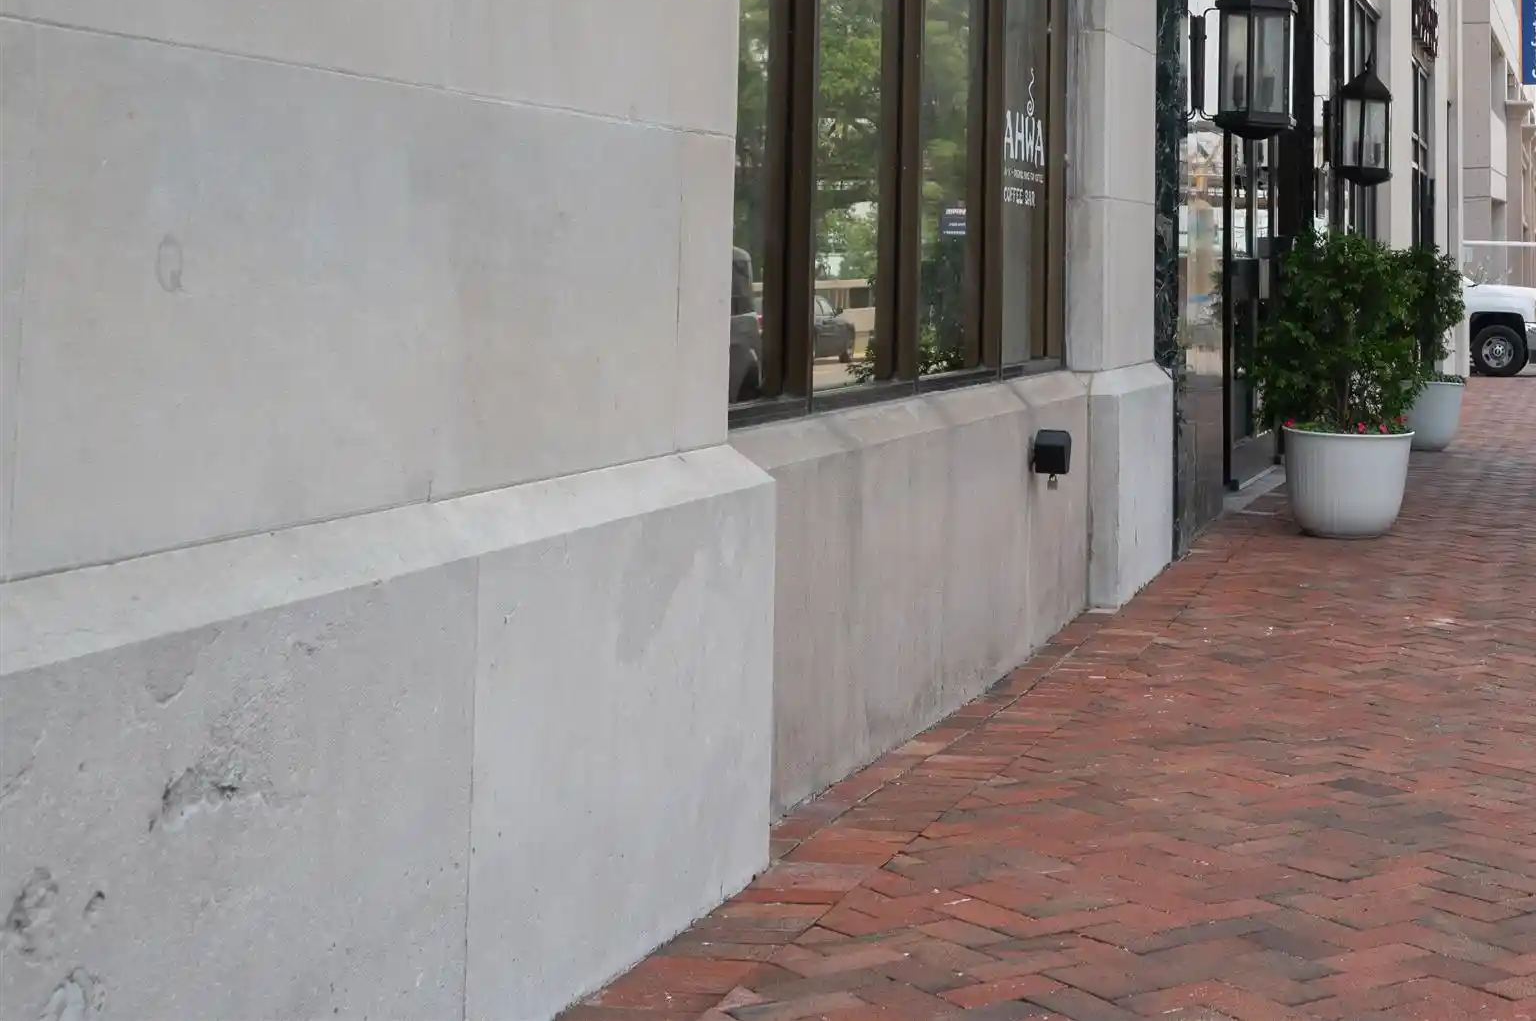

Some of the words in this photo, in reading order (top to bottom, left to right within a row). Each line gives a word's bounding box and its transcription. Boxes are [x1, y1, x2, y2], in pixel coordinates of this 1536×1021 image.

[1003, 109, 1045, 168] AHWA
[1003, 186, 1023, 205] COFFEE
[1024, 189, 1036, 207] BAR
